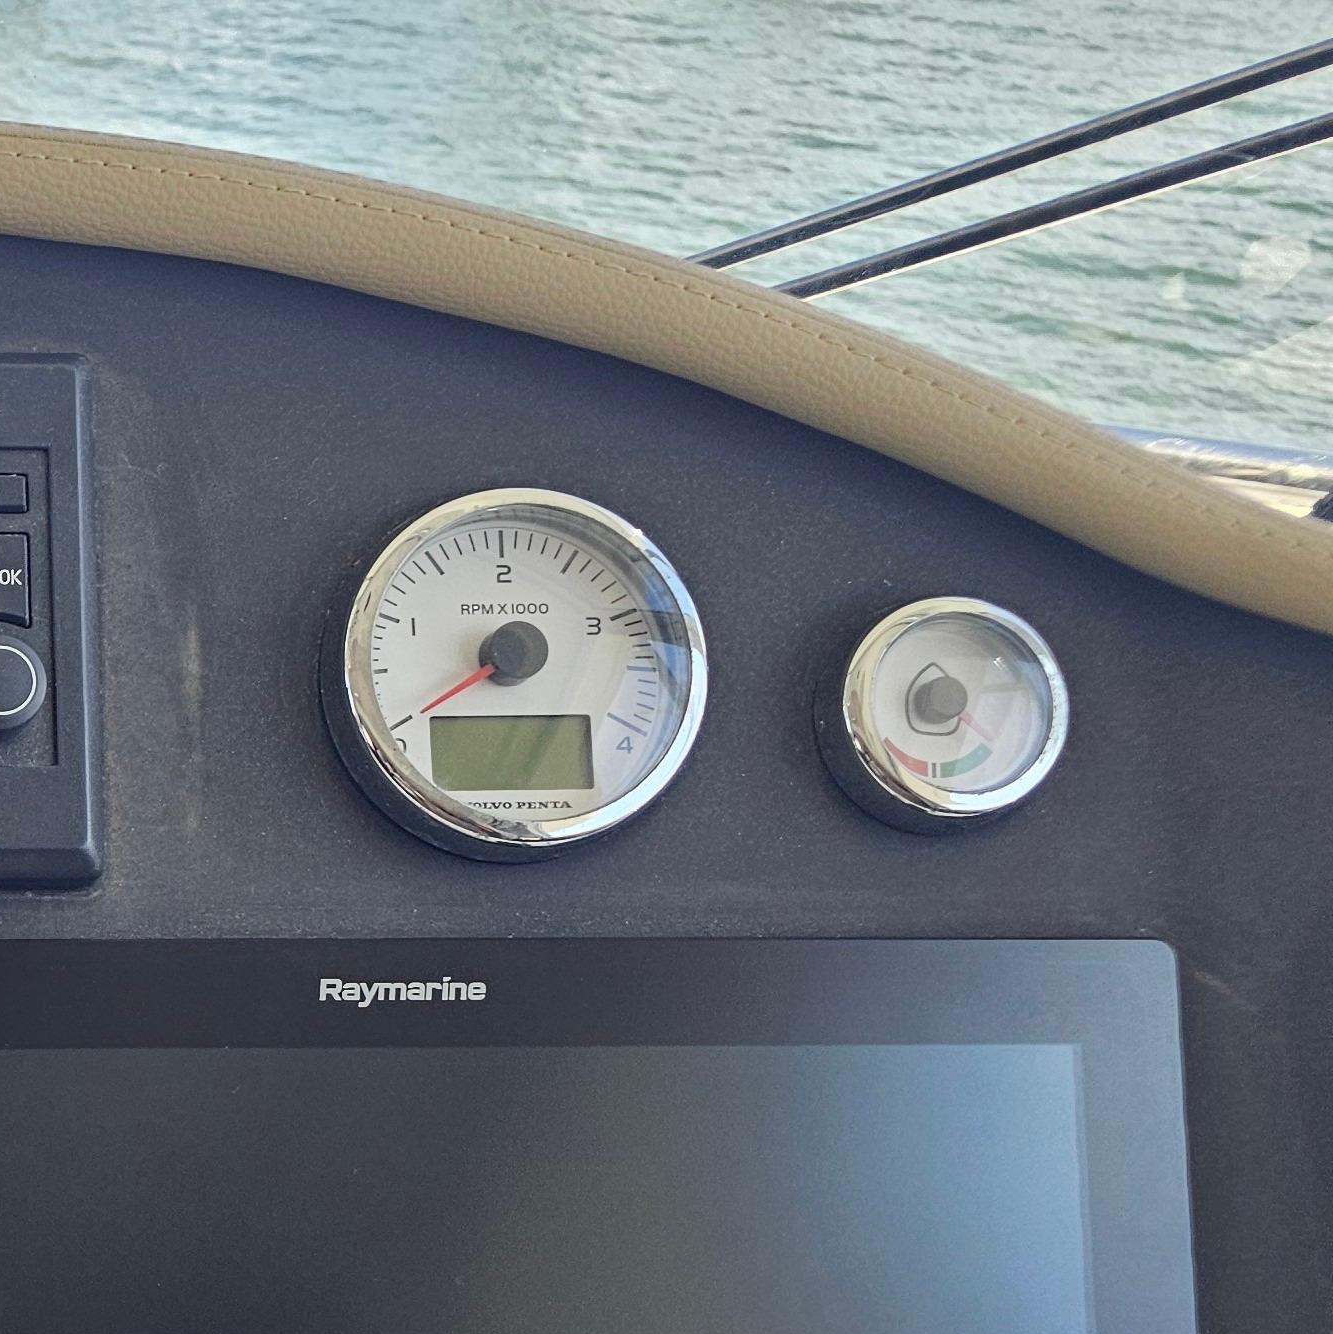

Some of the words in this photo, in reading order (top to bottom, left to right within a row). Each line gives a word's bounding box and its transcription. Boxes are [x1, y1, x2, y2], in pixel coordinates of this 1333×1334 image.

[495, 564, 513, 584] 2
[460, 603, 494, 616] RPM
[497, 603, 508, 615] X
[511, 602, 549, 615] 1000
[585, 616, 602, 636] 3
[615, 735, 634, 755] 4
[516, 800, 573, 810] PENTA
[318, 976, 487, 1008] Raymarine
